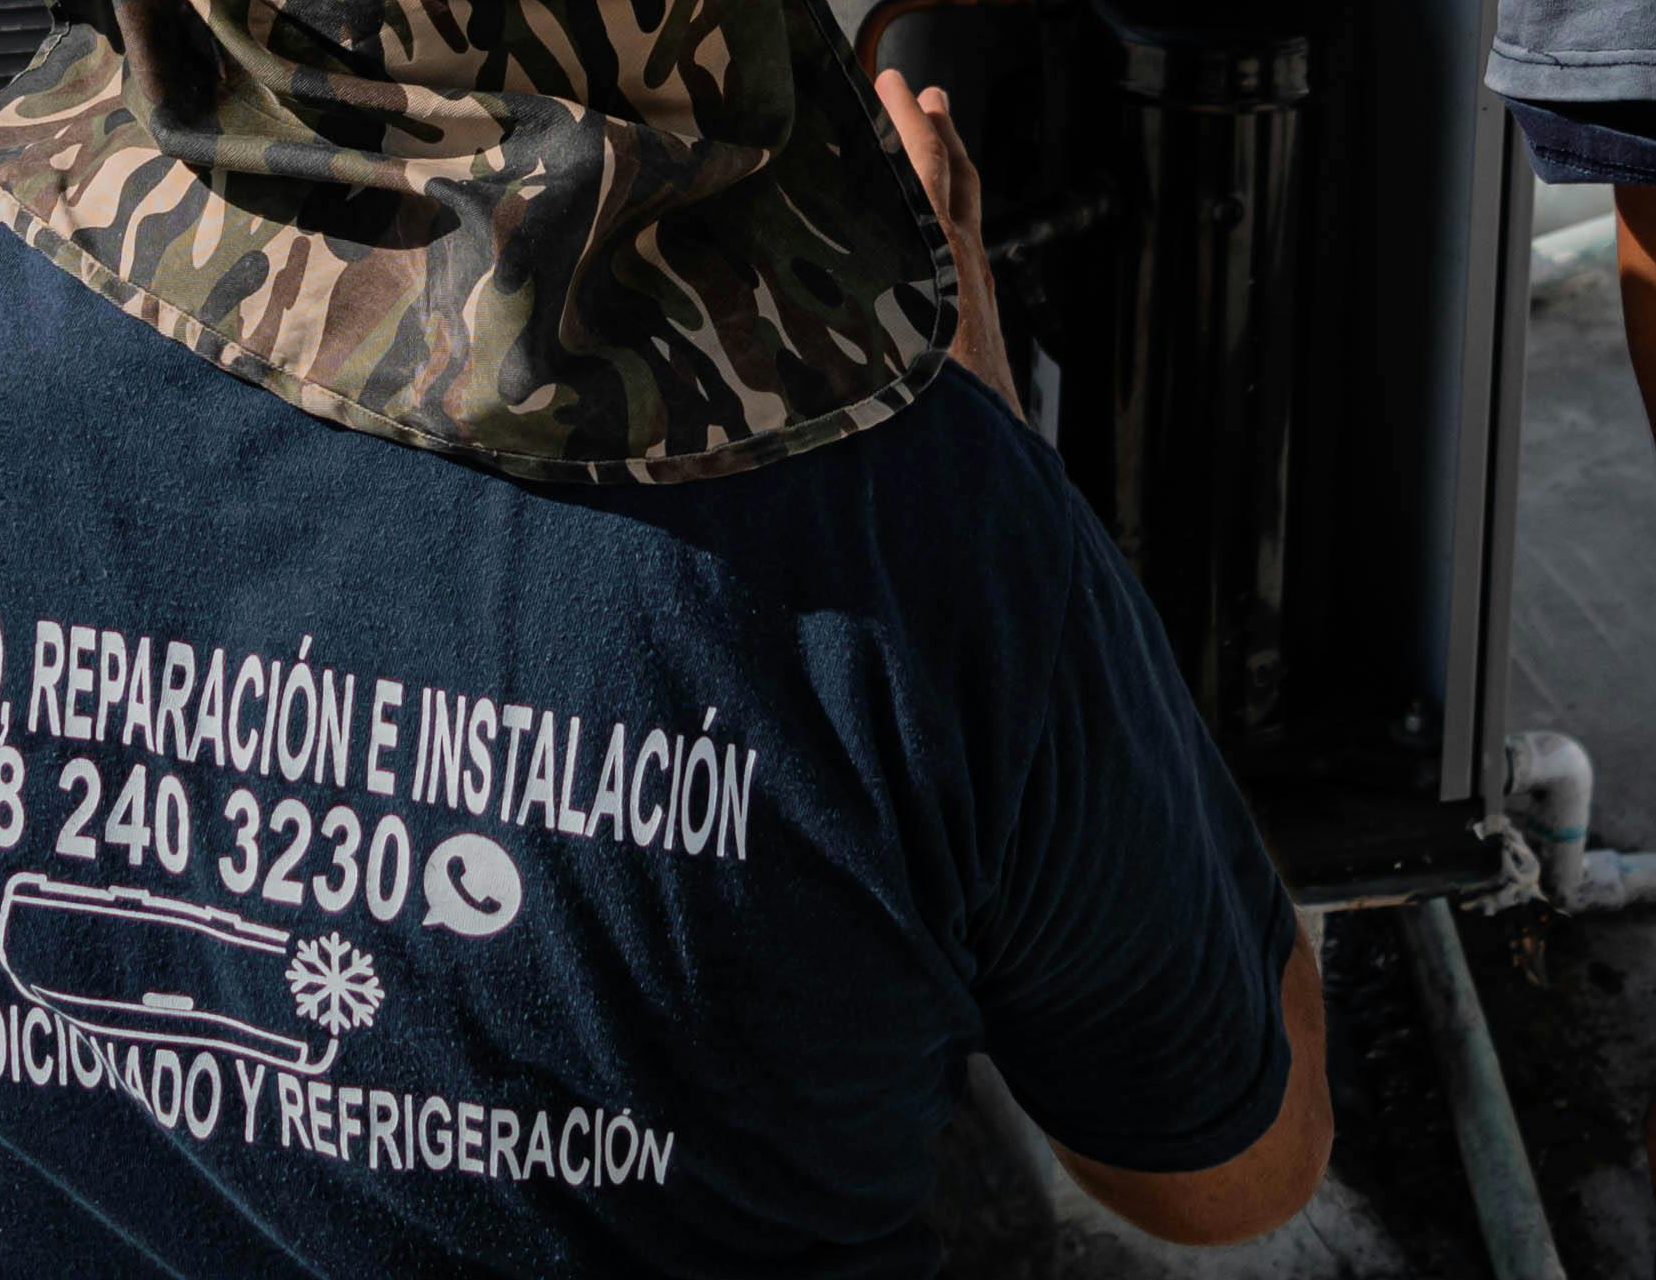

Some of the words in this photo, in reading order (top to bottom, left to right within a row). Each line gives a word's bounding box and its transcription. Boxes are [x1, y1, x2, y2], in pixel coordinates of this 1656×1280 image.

[27, 620, 355, 788] REPARACIÓN
[367, 678, 405, 796] E
[411, 687, 757, 860] INSTALACIÓN
[55, 757, 191, 874] 240
[218, 788, 412, 921] 3230
[235, 1058, 267, 1143] Y
[277, 1072, 675, 1187] REFRIGERACIÓN
